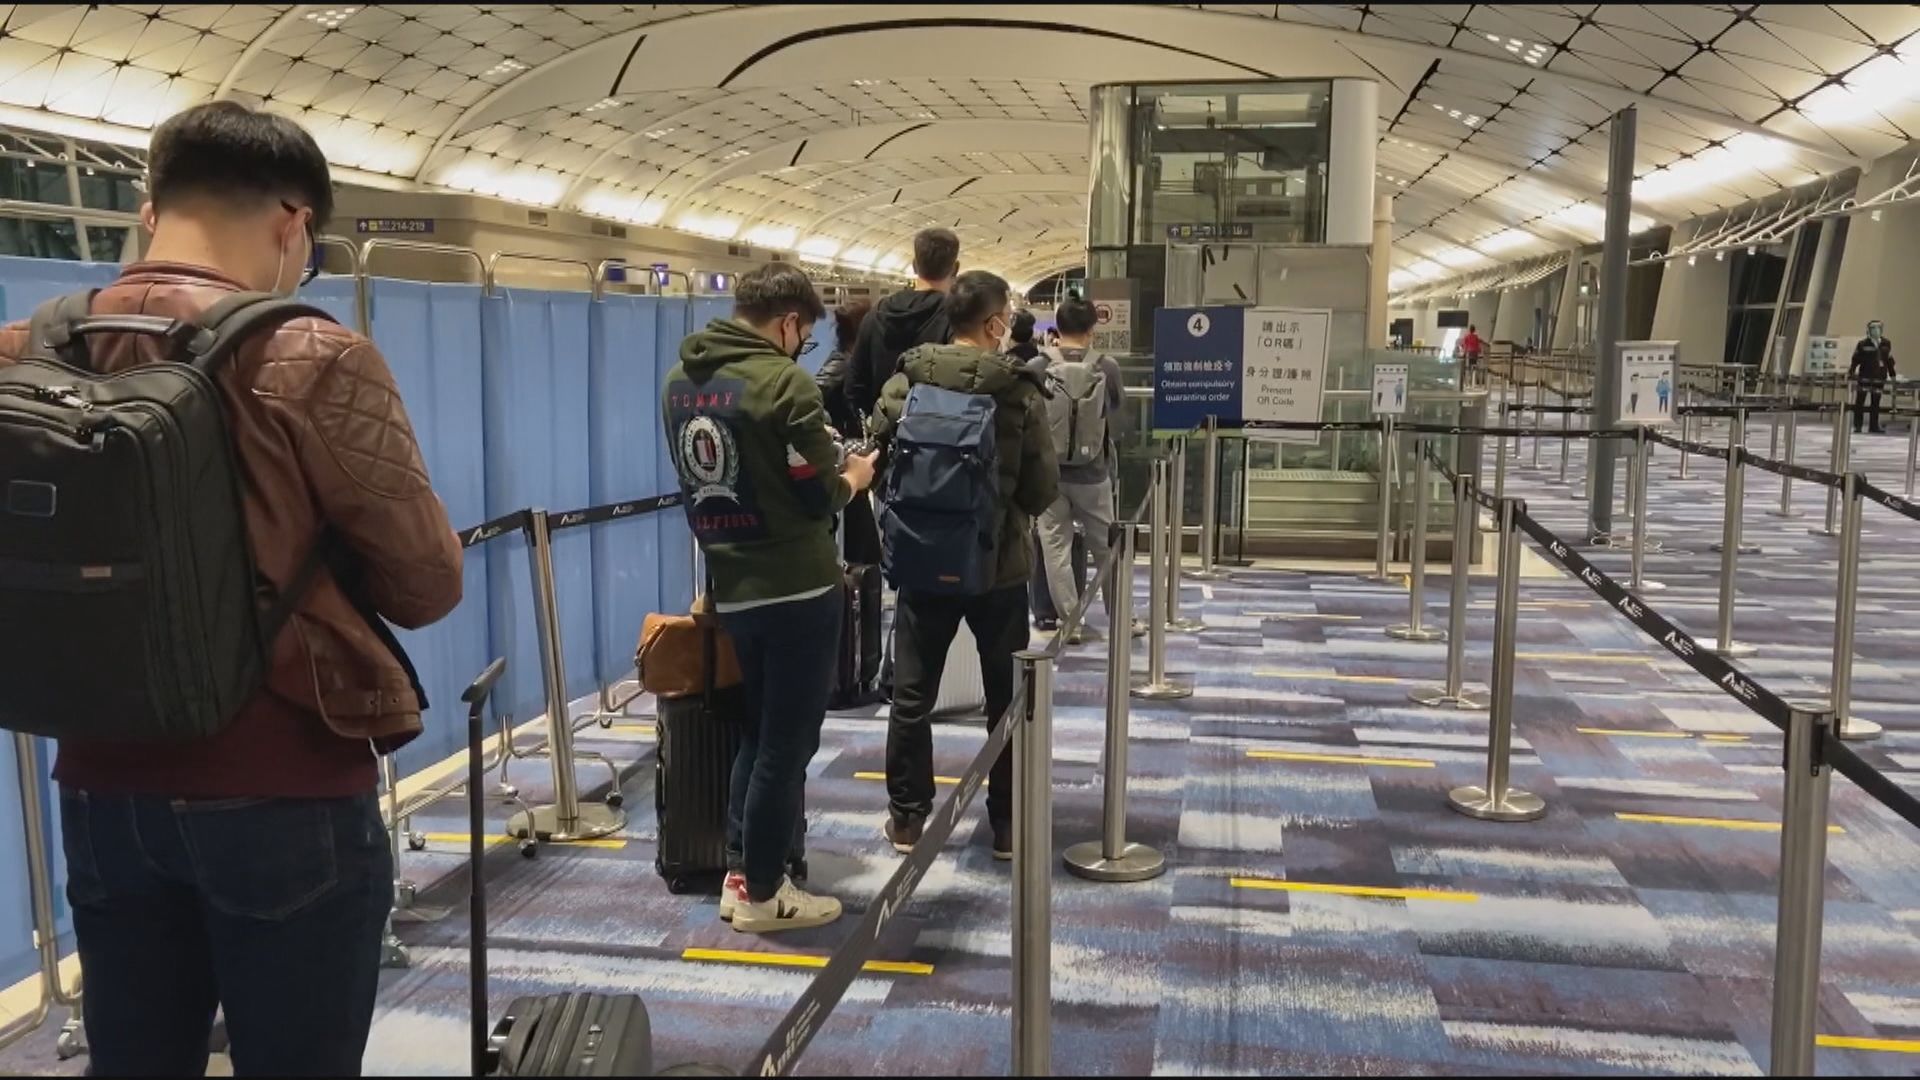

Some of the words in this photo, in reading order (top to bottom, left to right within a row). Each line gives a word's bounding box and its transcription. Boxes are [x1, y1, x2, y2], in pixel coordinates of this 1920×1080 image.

[1192, 318, 1203, 332] 4
[1262, 320, 1300, 333] 請出示
[1161, 380, 1187, 388] Obtain
[1188, 380, 1235, 389] compulsory
[1261, 384, 1292, 395] Present
[672, 392, 733, 407] TOMMY
[1165, 393, 1207, 403] quarantine
[1208, 392, 1230, 401] order
[1257, 396, 1270, 406] QR
[1272, 396, 1295, 407] Code
